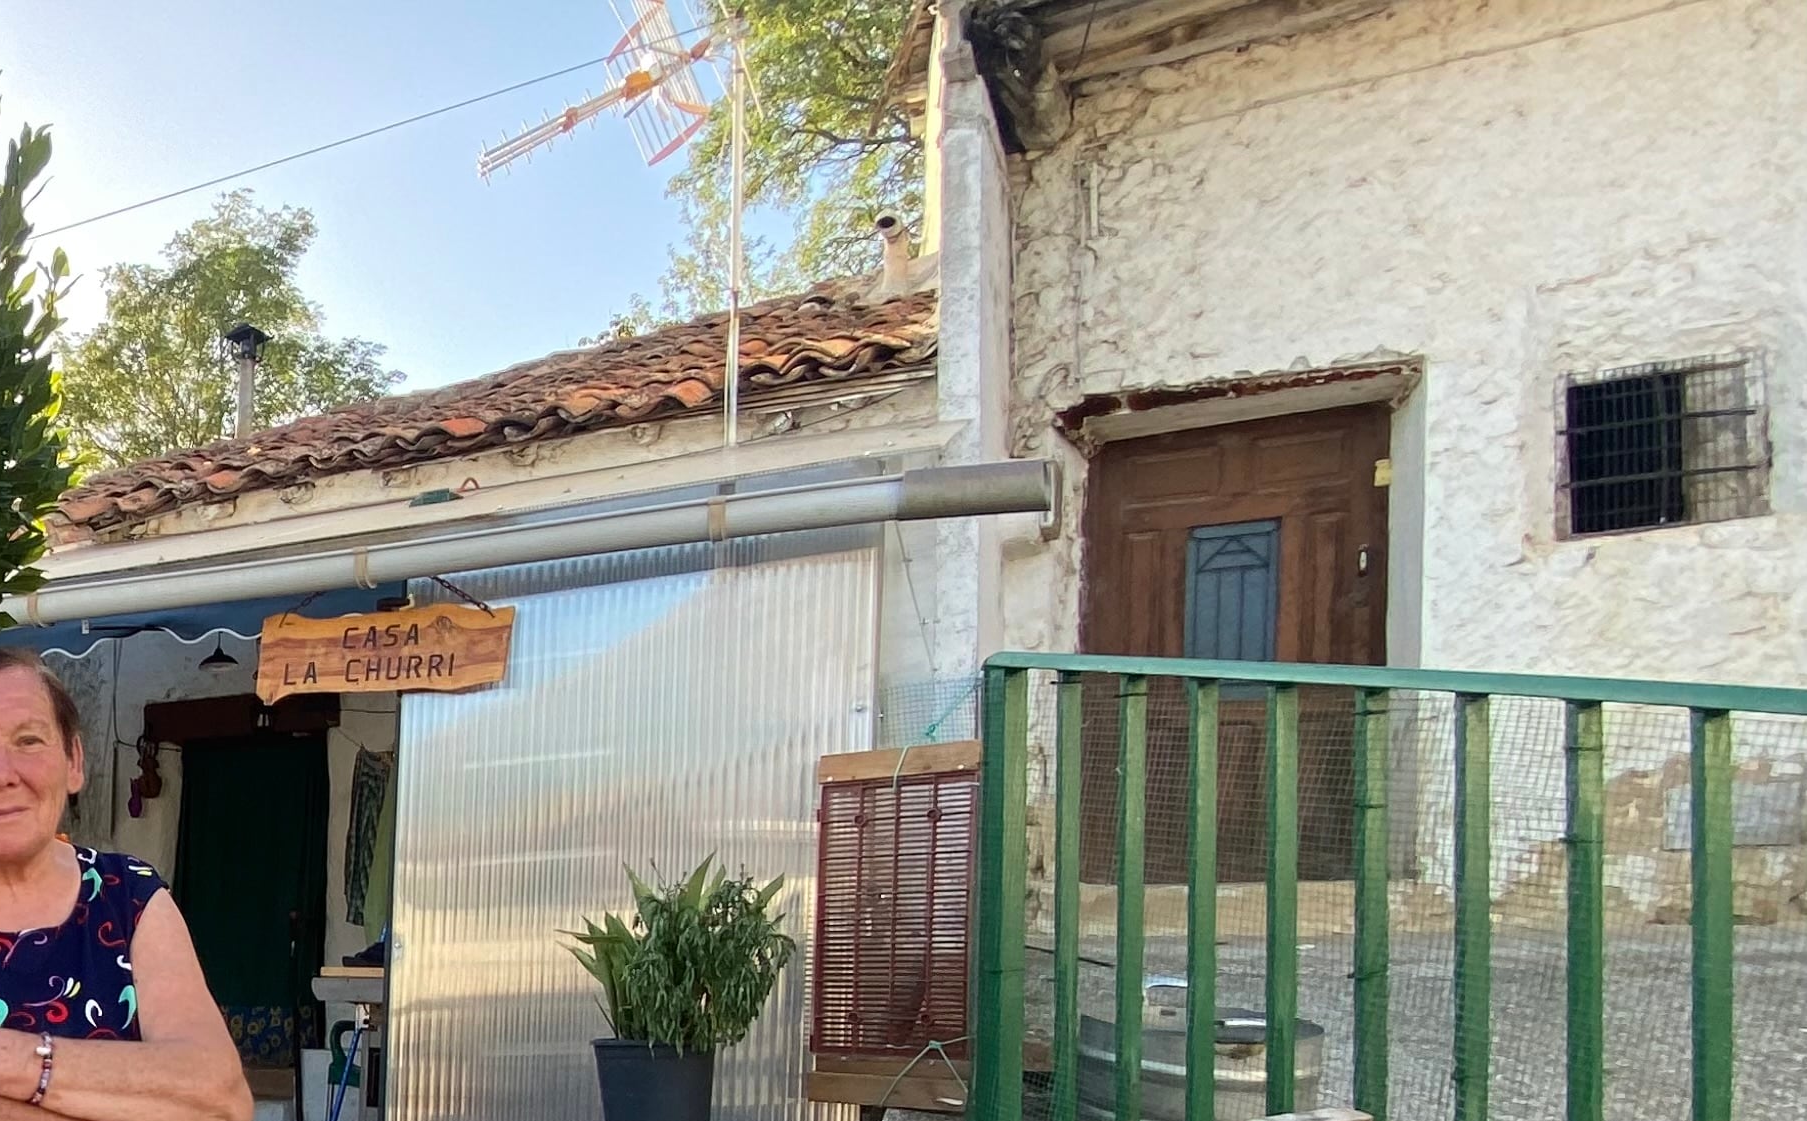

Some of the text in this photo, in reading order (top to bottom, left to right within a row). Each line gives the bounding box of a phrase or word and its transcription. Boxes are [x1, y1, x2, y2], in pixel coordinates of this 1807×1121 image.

[343, 623, 420, 650] CASA
[283, 653, 455, 686] LA CHURRI
